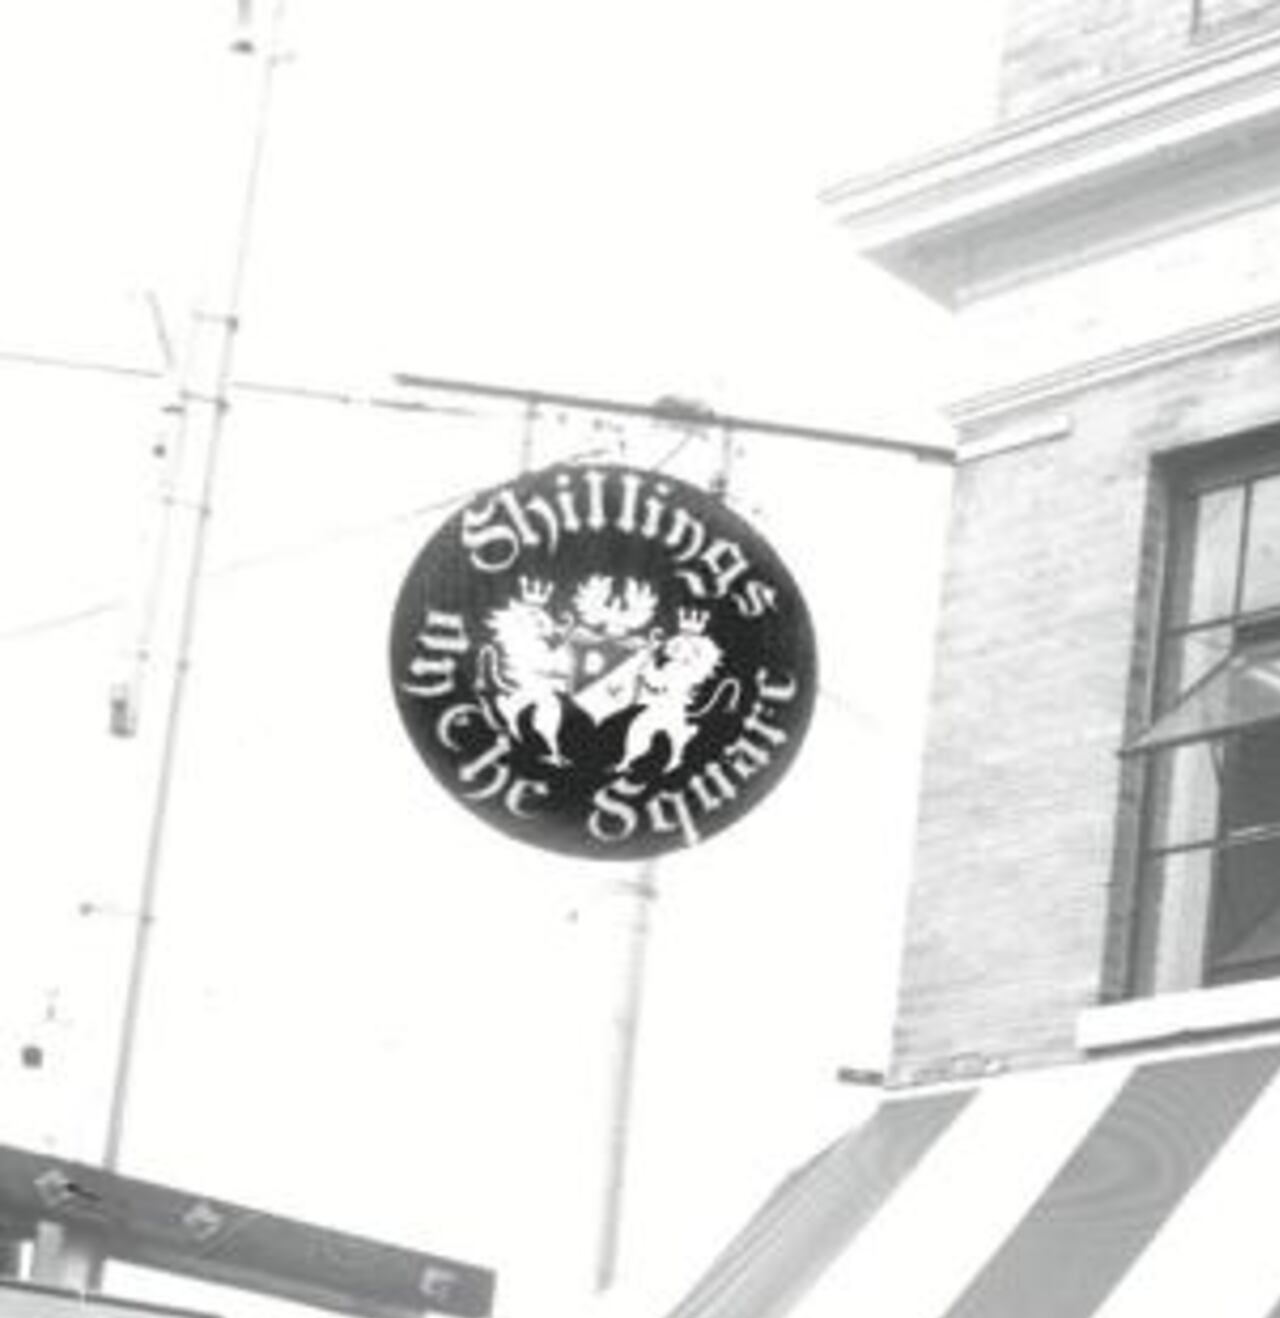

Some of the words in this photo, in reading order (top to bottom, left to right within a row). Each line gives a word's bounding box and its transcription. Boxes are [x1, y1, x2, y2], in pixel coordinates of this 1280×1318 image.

[461, 469, 778, 618] Shillings
[437, 703, 550, 819] The
[587, 667, 797, 847] Square
